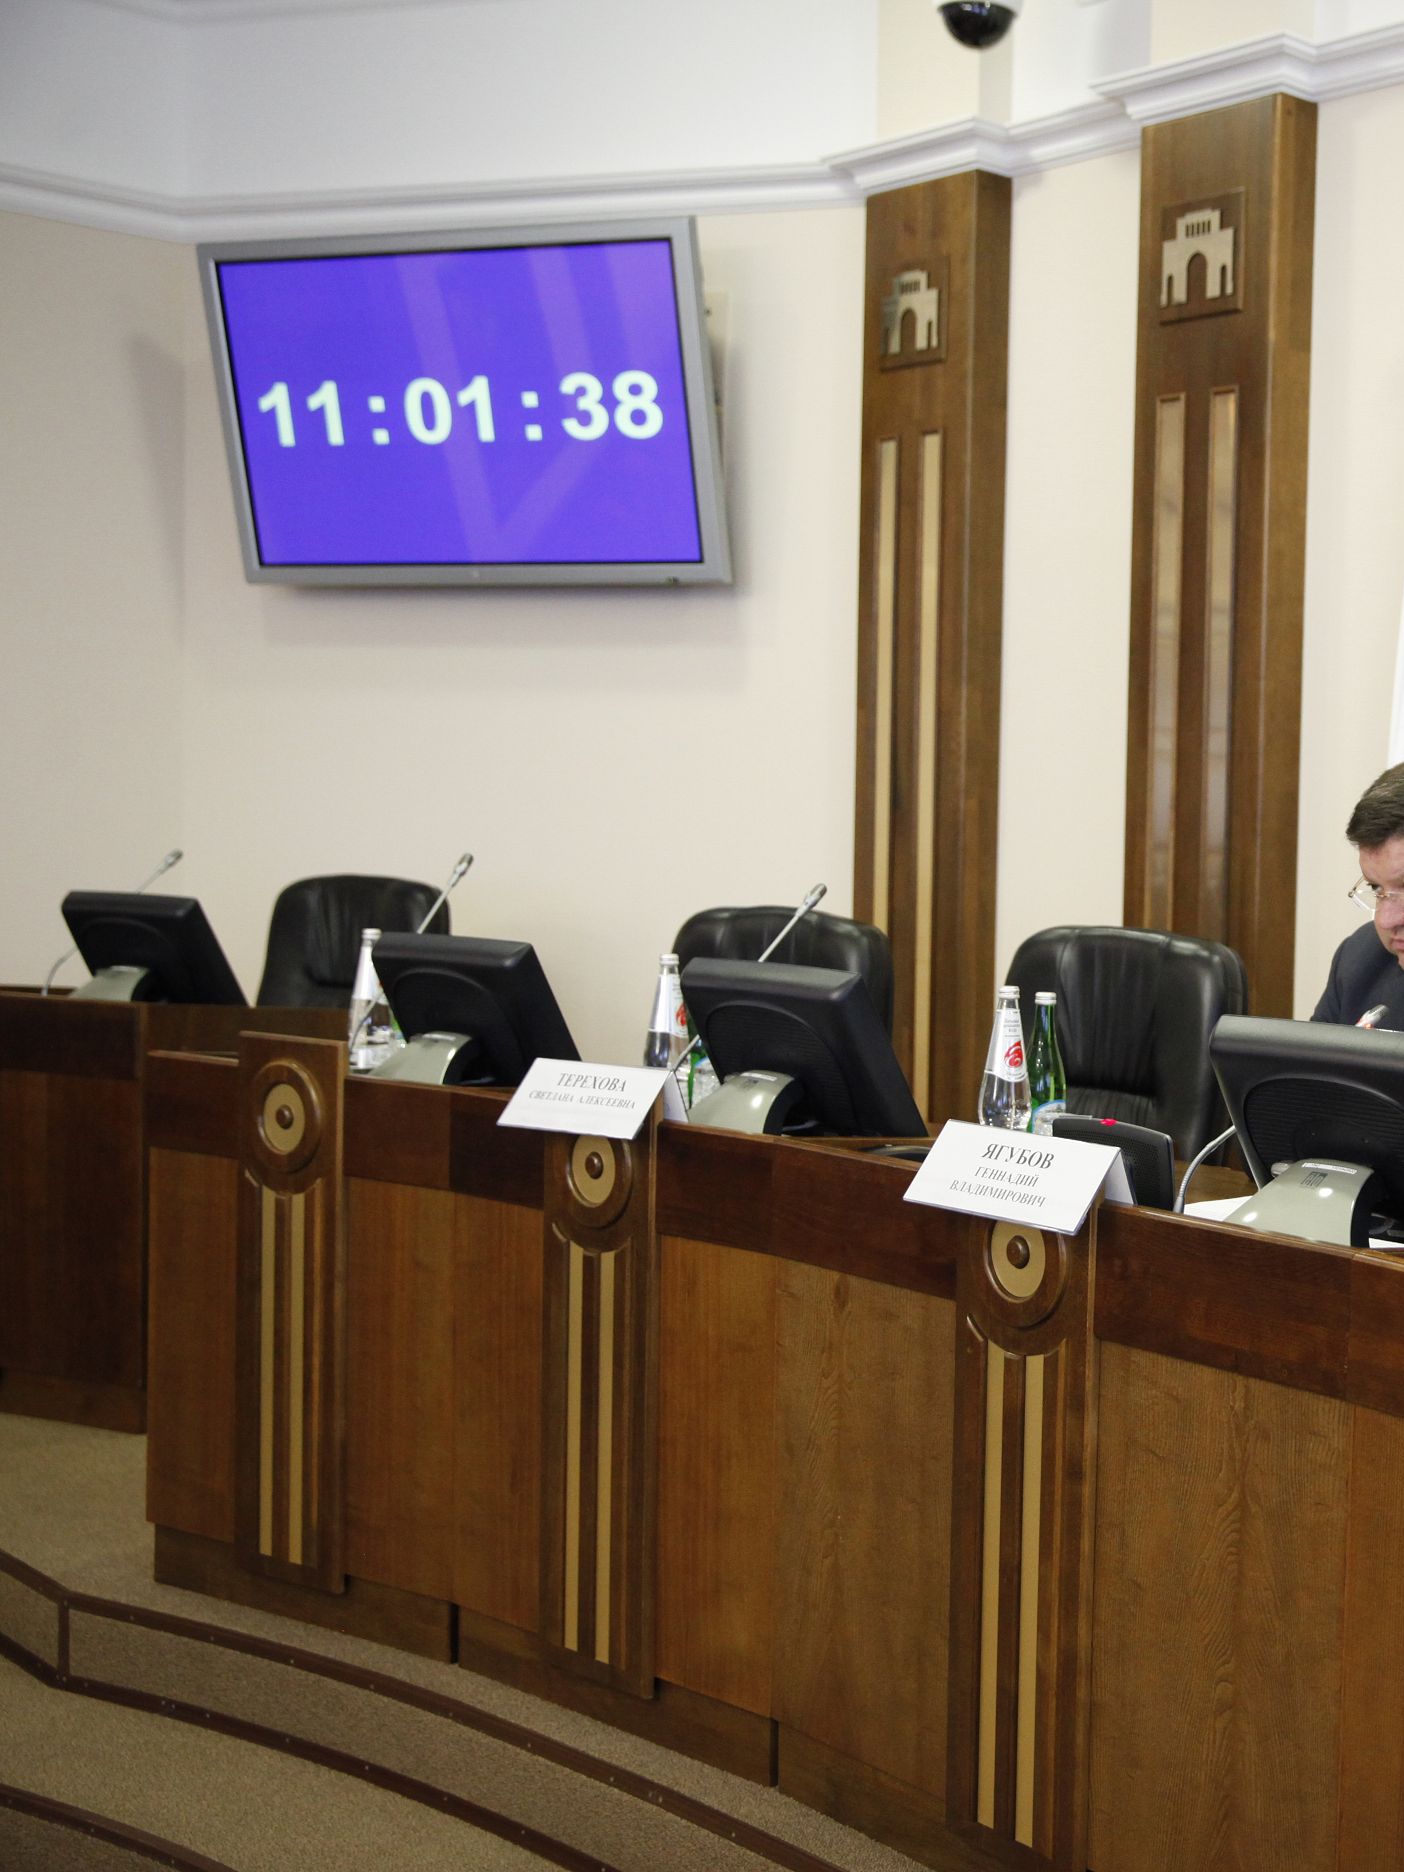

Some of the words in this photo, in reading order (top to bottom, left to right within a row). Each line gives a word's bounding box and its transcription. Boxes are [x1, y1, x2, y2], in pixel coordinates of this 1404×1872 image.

[556, 1073, 627, 1092] ТЕРЕХОВА
[529, 1090, 574, 1103] СВЕТЛАНА
[980, 1143, 1056, 1170] ЯГУБОВ
[973, 1166, 1040, 1188] ГЕННАДИЙ
[950, 1180, 1046, 1207] ВЛАДИМИРОВИЧ
